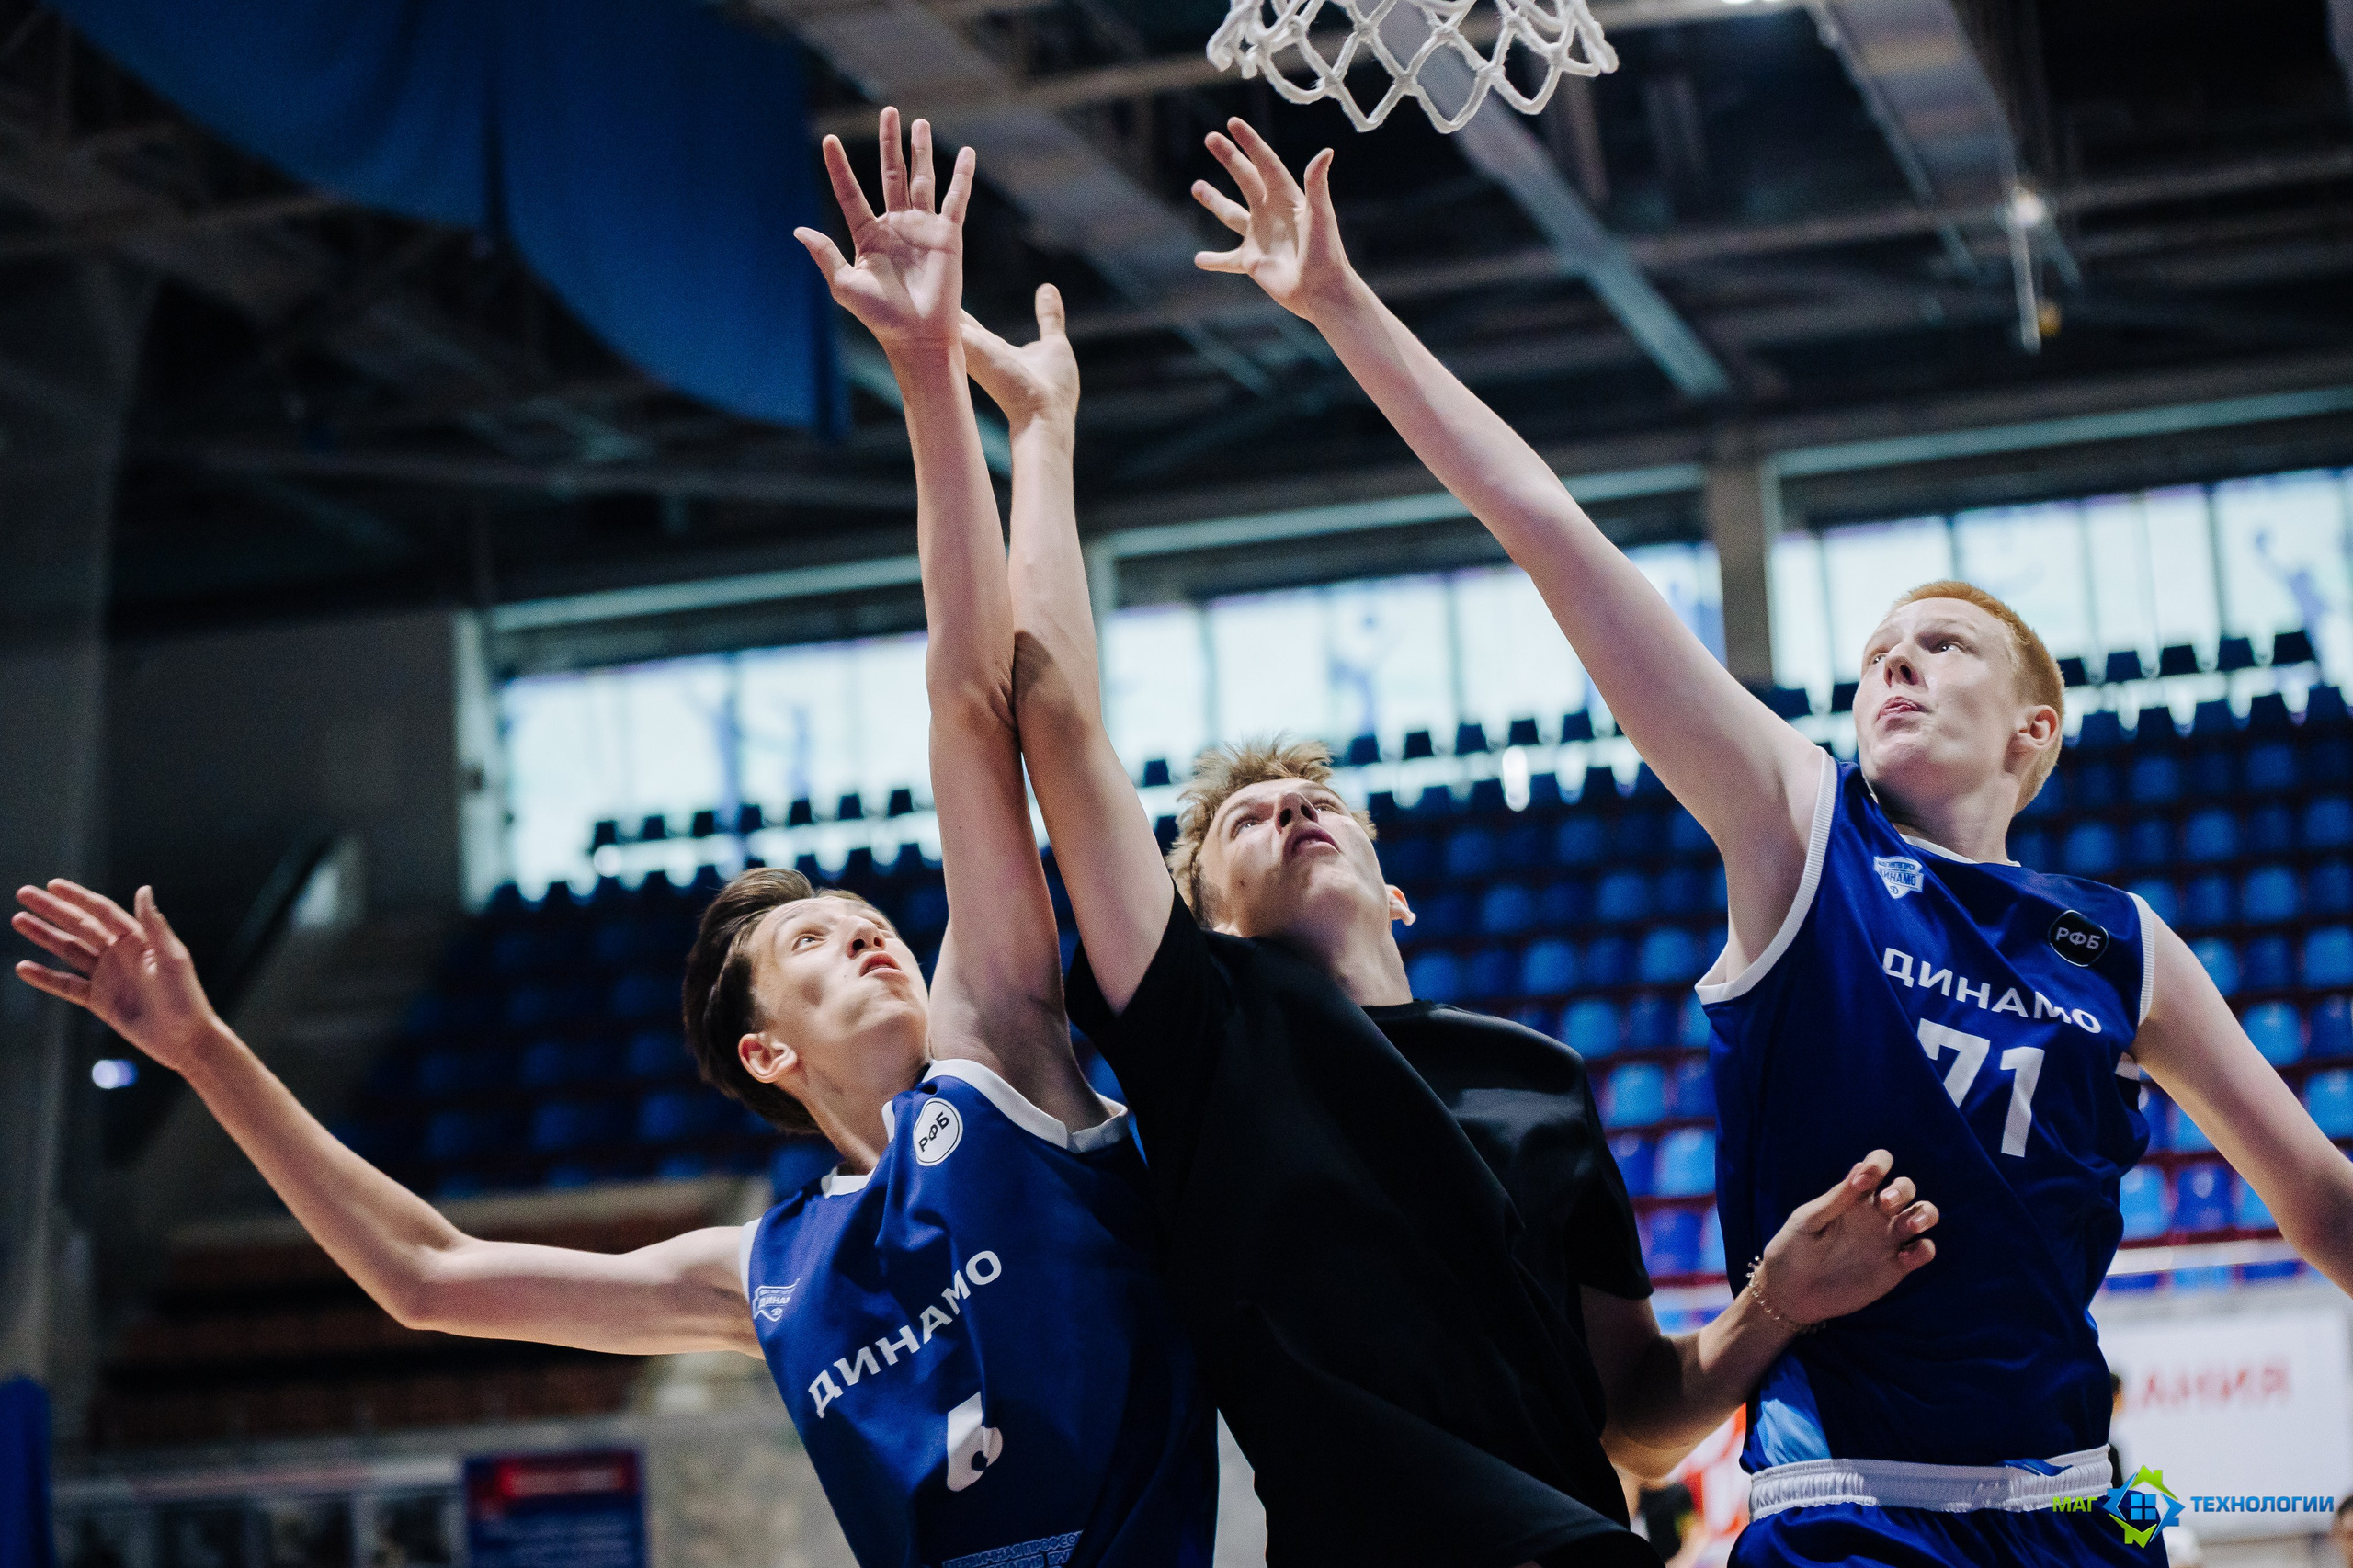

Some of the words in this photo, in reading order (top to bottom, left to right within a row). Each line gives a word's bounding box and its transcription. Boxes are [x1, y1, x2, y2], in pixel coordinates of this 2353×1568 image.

[2055, 926, 2101, 949] РФБ
[1882, 947, 2102, 1034] ДИНАМО
[1917, 1017, 2045, 1158] 71
[918, 1110, 949, 1153] РФБ
[807, 1250, 1002, 1419] ДИНАМО
[947, 1392, 1003, 1492] 6
[1022, 1532, 1079, 1554] ПРОФСО
